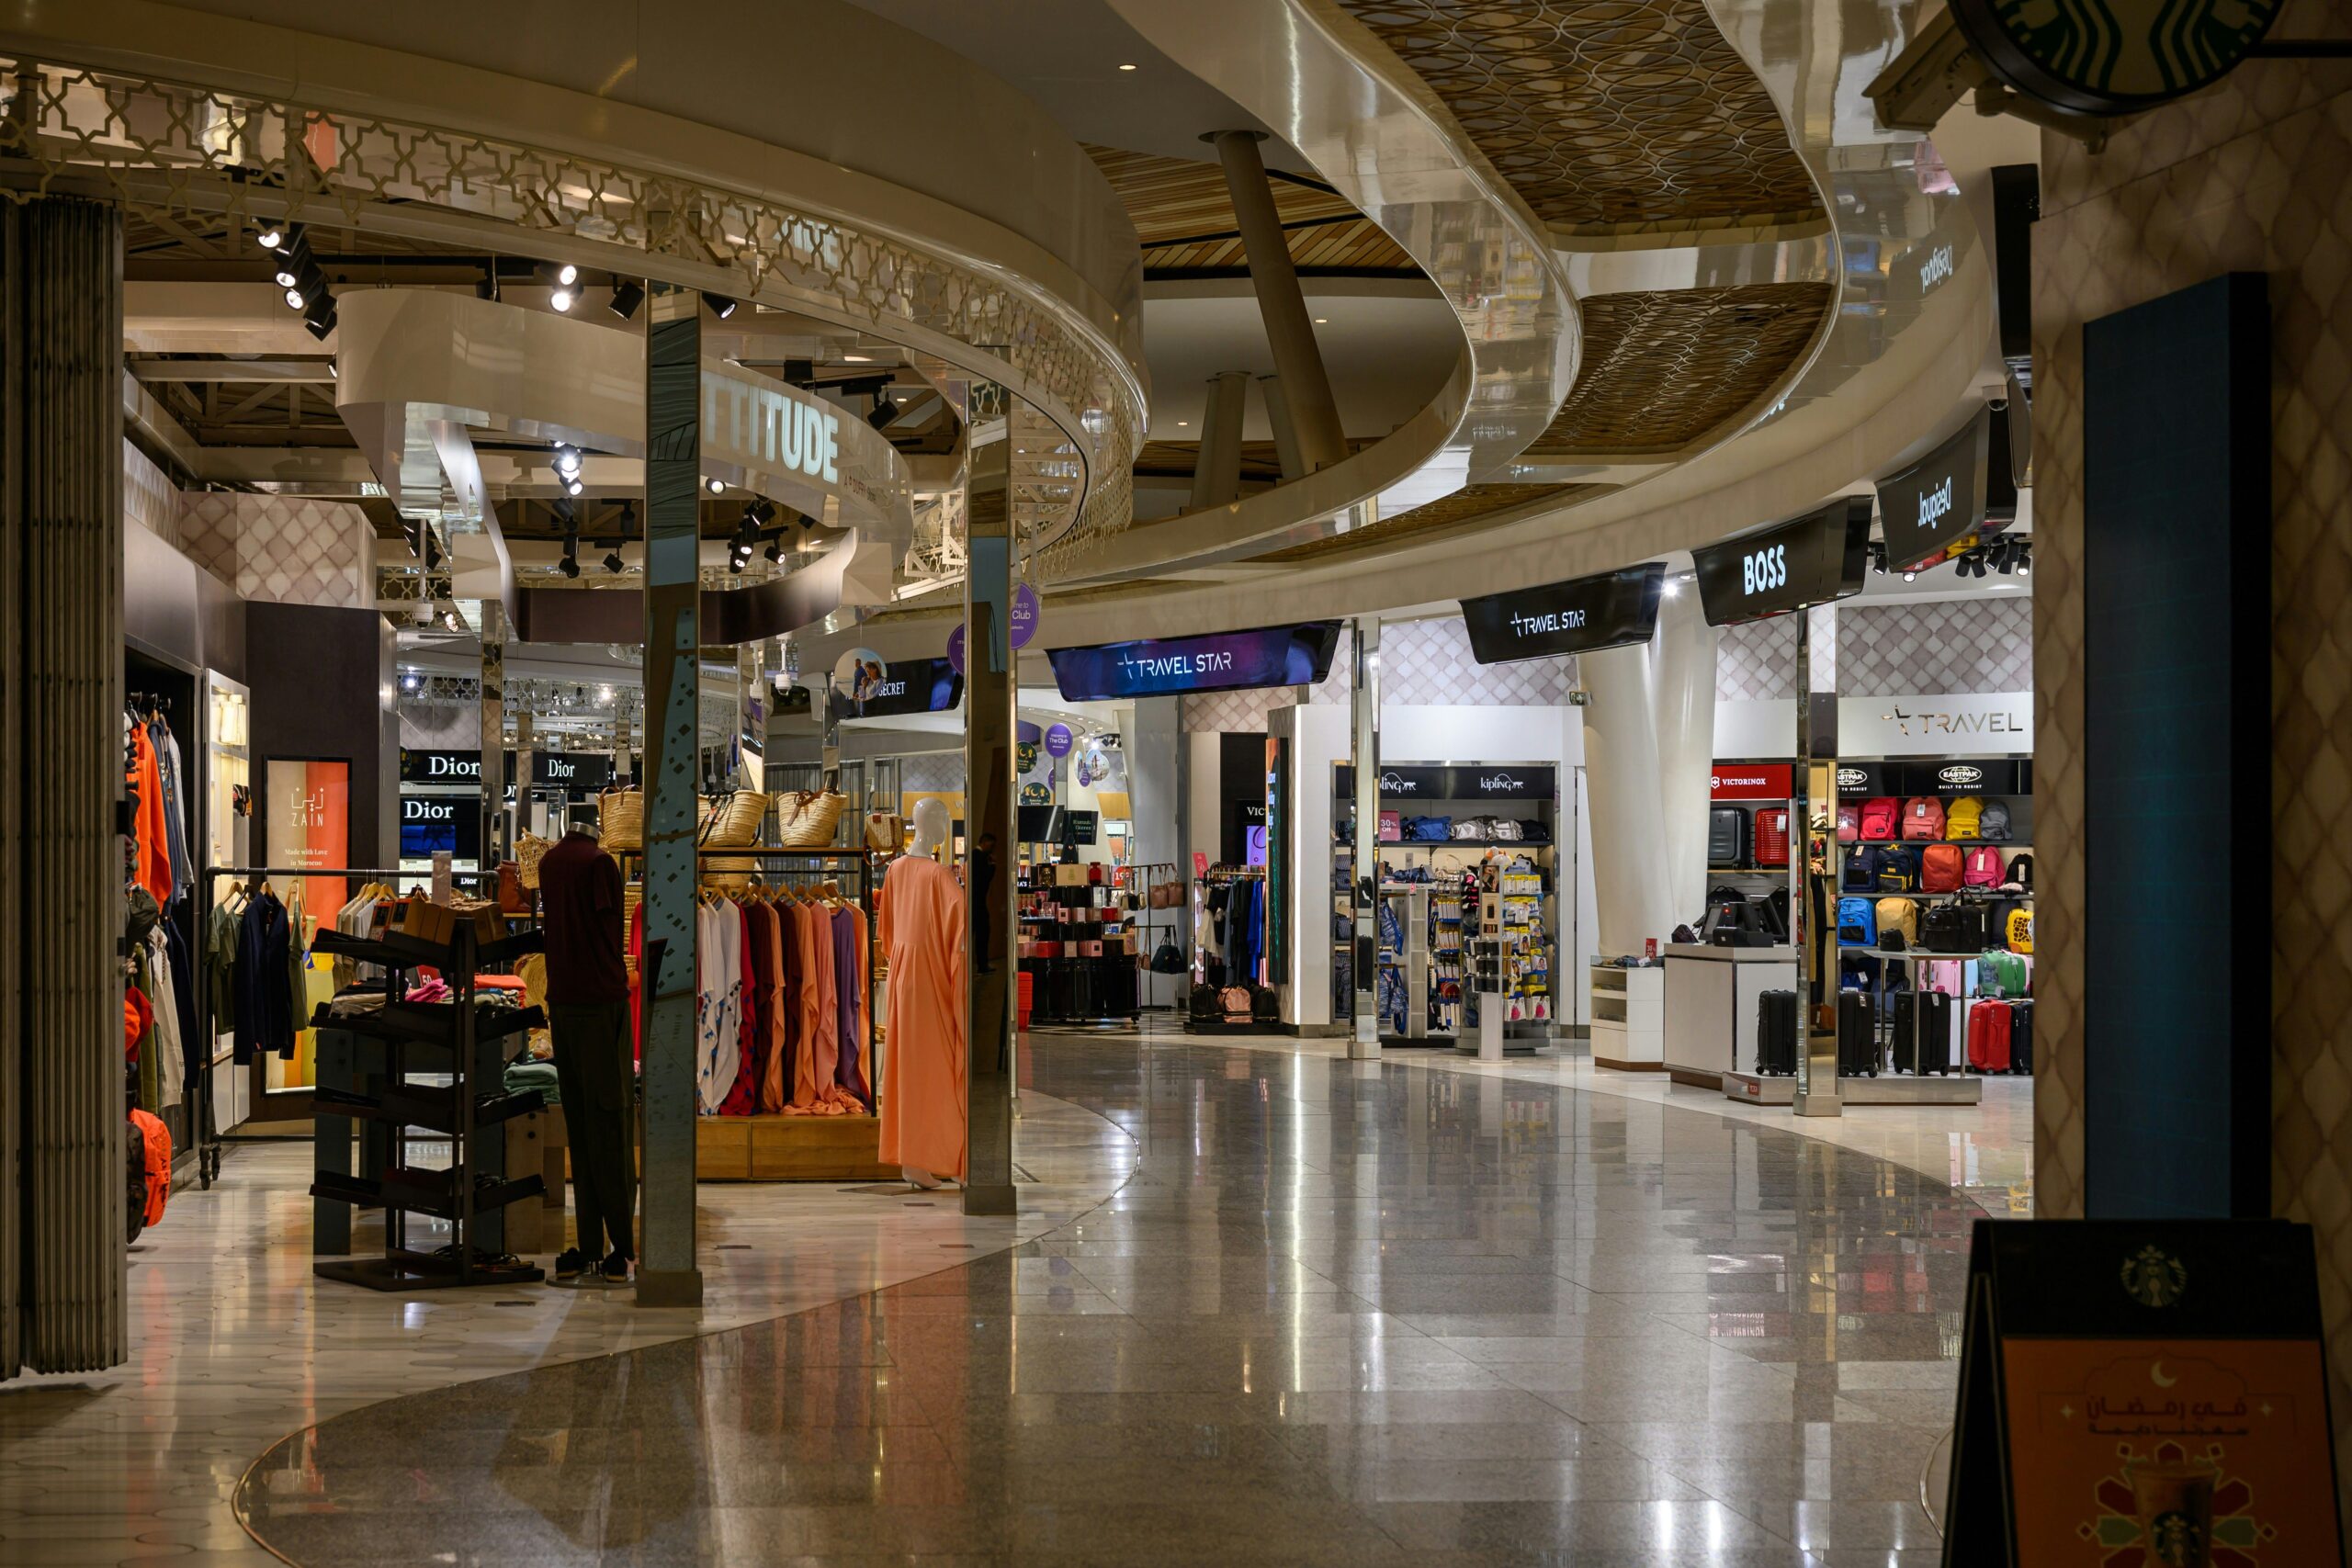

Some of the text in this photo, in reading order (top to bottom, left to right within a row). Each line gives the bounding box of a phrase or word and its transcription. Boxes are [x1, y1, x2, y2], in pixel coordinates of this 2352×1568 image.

[701, 370, 838, 484] TTITUDE
[1744, 544, 1786, 595] BOSS
[1012, 610, 1031, 620] Club
[1522, 609, 1586, 636] TRAVEL STAR
[1136, 651, 1232, 678] TRAVEL STAR
[1918, 712, 2024, 735] TRAVEL
[428, 756, 481, 776] Dior
[548, 759, 575, 778] Dior
[1380, 776, 1402, 794] ling
[1480, 777, 1511, 792] kipling
[1722, 778, 1766, 786] VICTORINOX
[404, 801, 454, 818] Dior
[1247, 807, 1267, 817] VIC
[291, 813, 323, 827] ZAIN
[314, 848, 329, 856] Love
[2086, 1396, 2247, 1421] في رمضان
